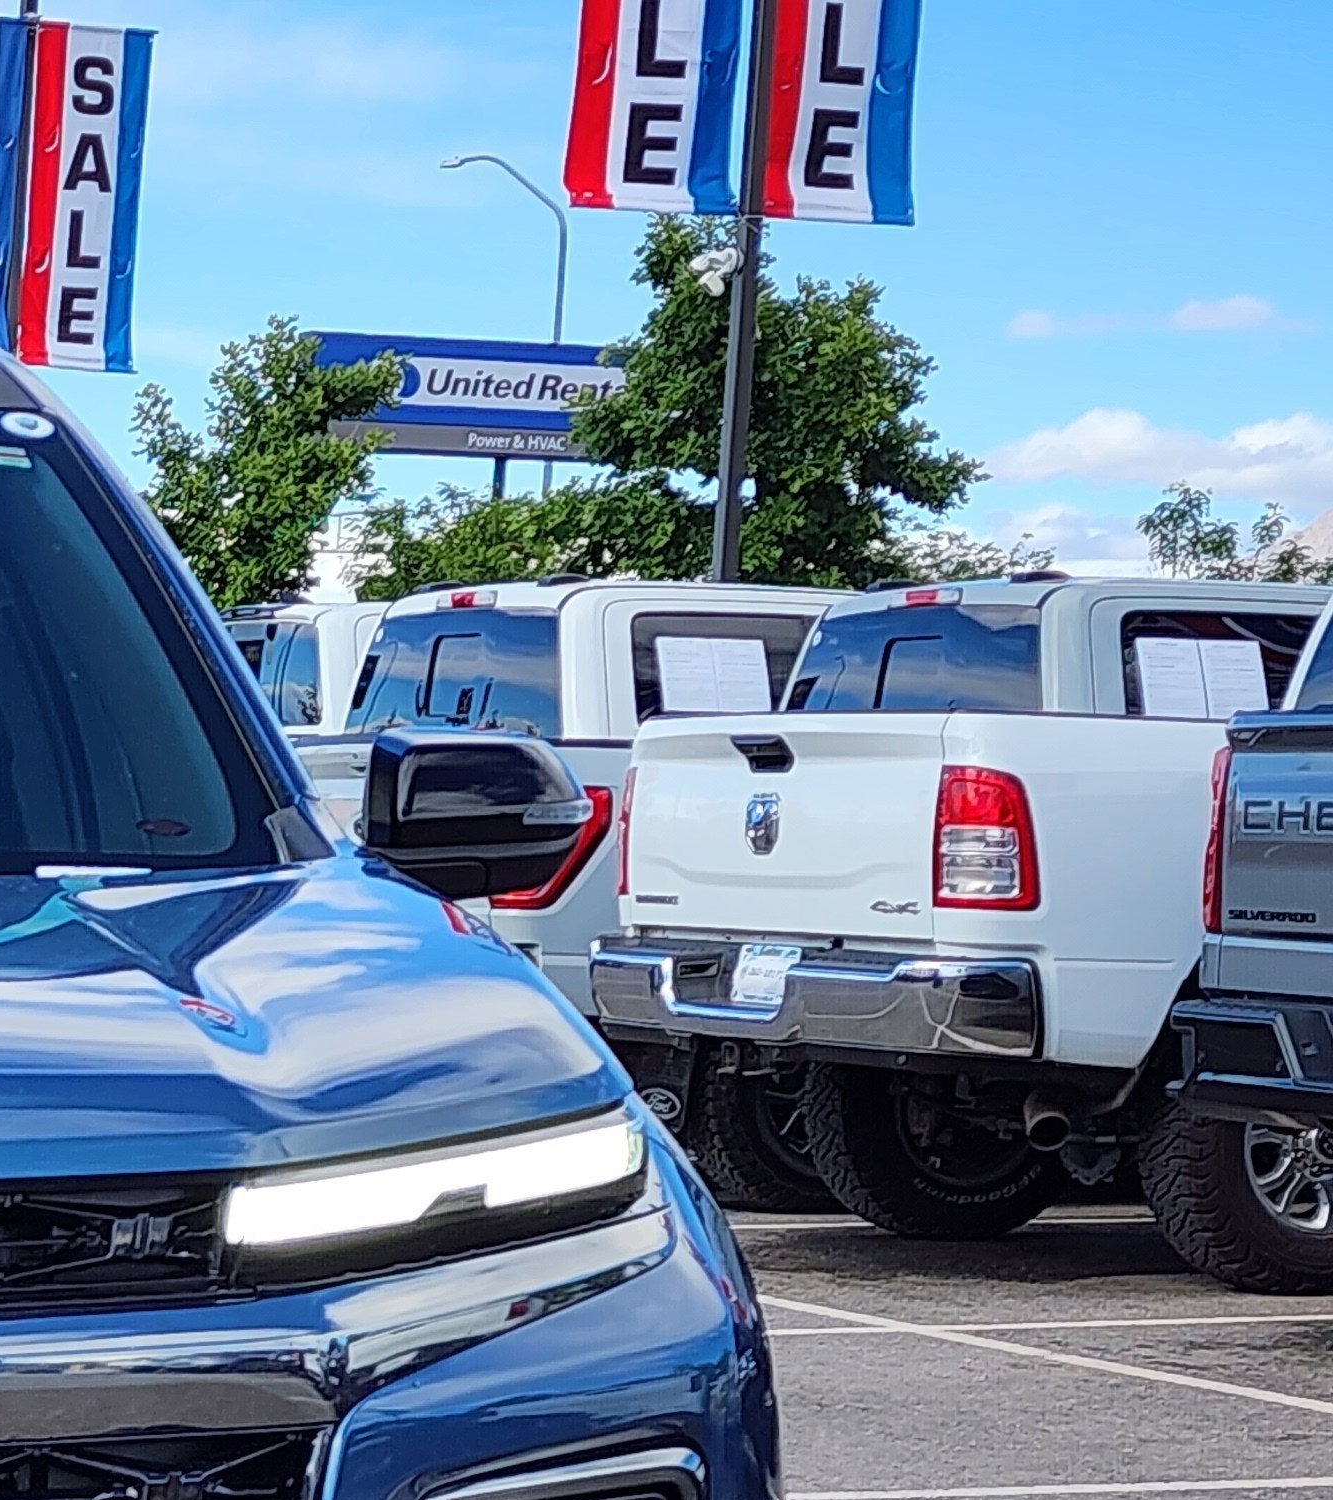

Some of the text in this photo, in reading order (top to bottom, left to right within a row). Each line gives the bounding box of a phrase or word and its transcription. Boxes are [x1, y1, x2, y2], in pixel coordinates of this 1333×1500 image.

[56, 56, 115, 346] SALE
[427, 367, 536, 401] United
[468, 432, 567, 451] Power & HVAC
